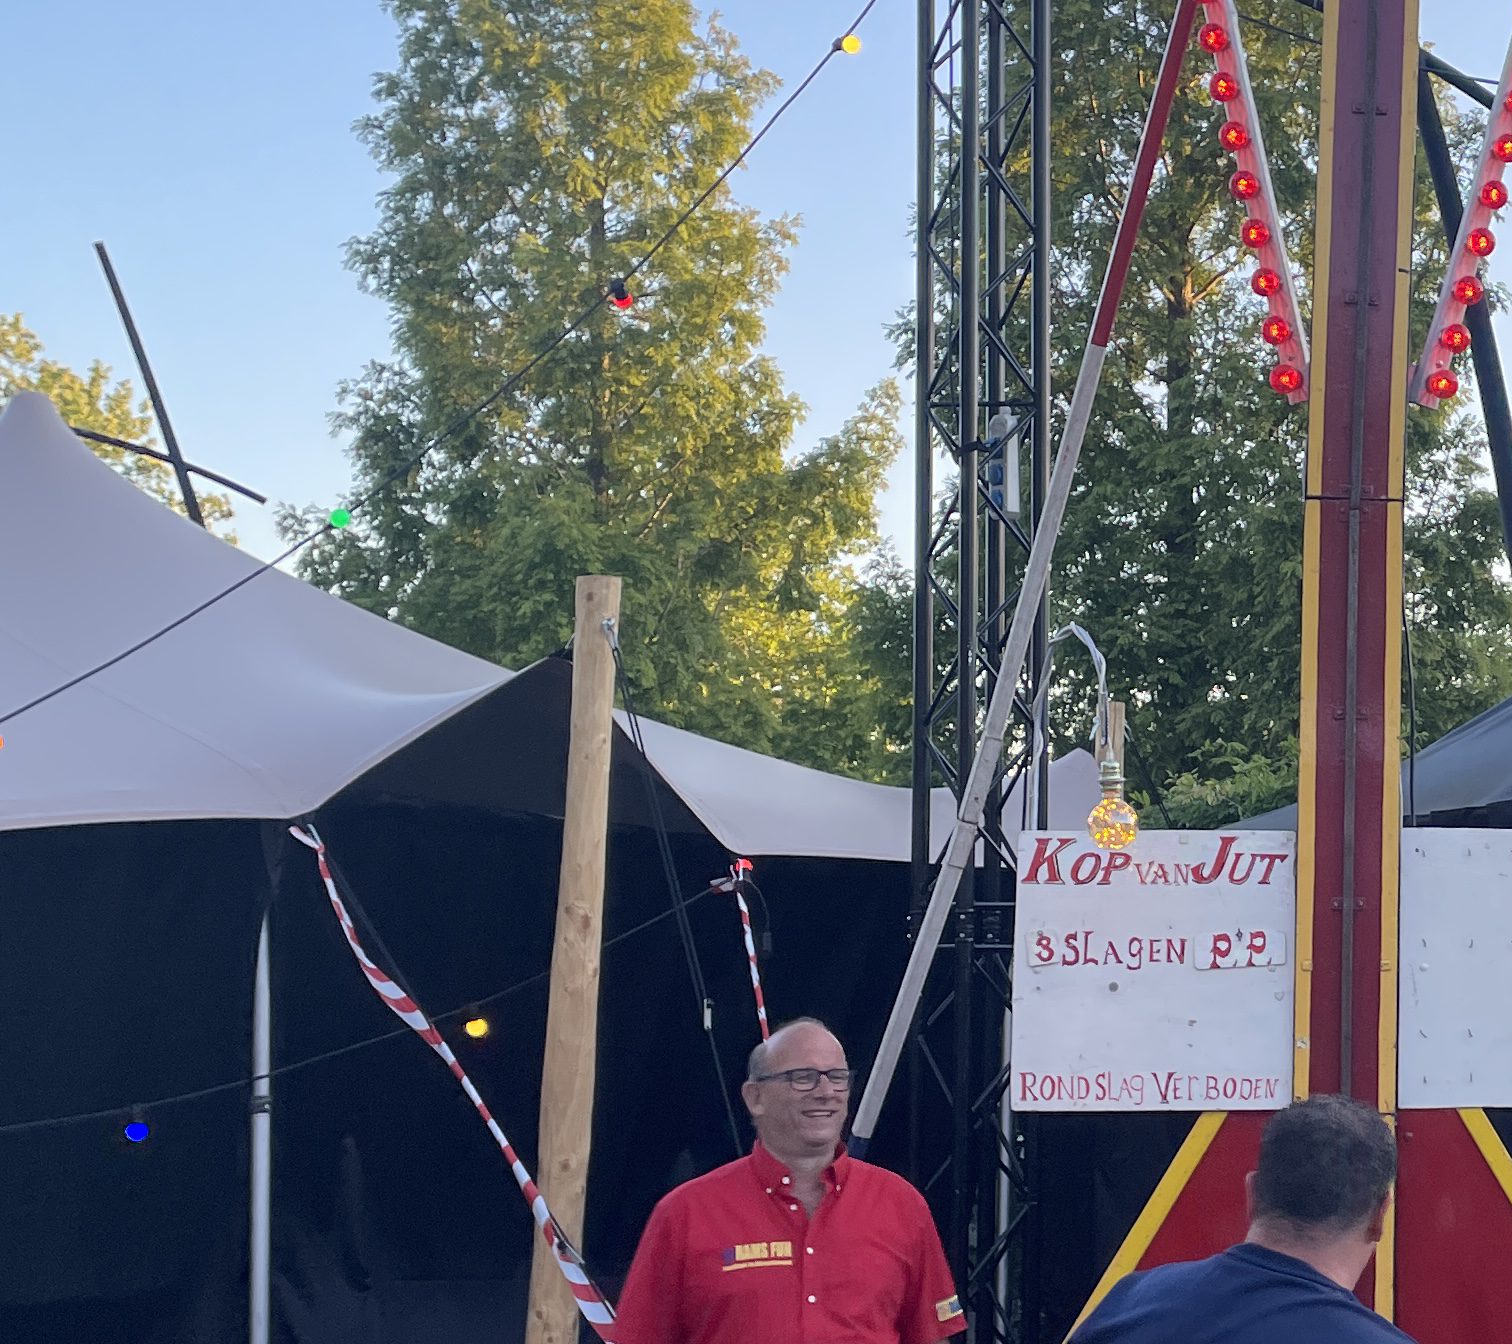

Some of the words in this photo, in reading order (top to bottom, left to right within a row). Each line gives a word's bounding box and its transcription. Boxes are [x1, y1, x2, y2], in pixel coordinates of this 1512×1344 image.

[1021, 837, 1133, 886] KOP
[1133, 860, 1192, 887] VAN
[1191, 836, 1289, 885] JUT
